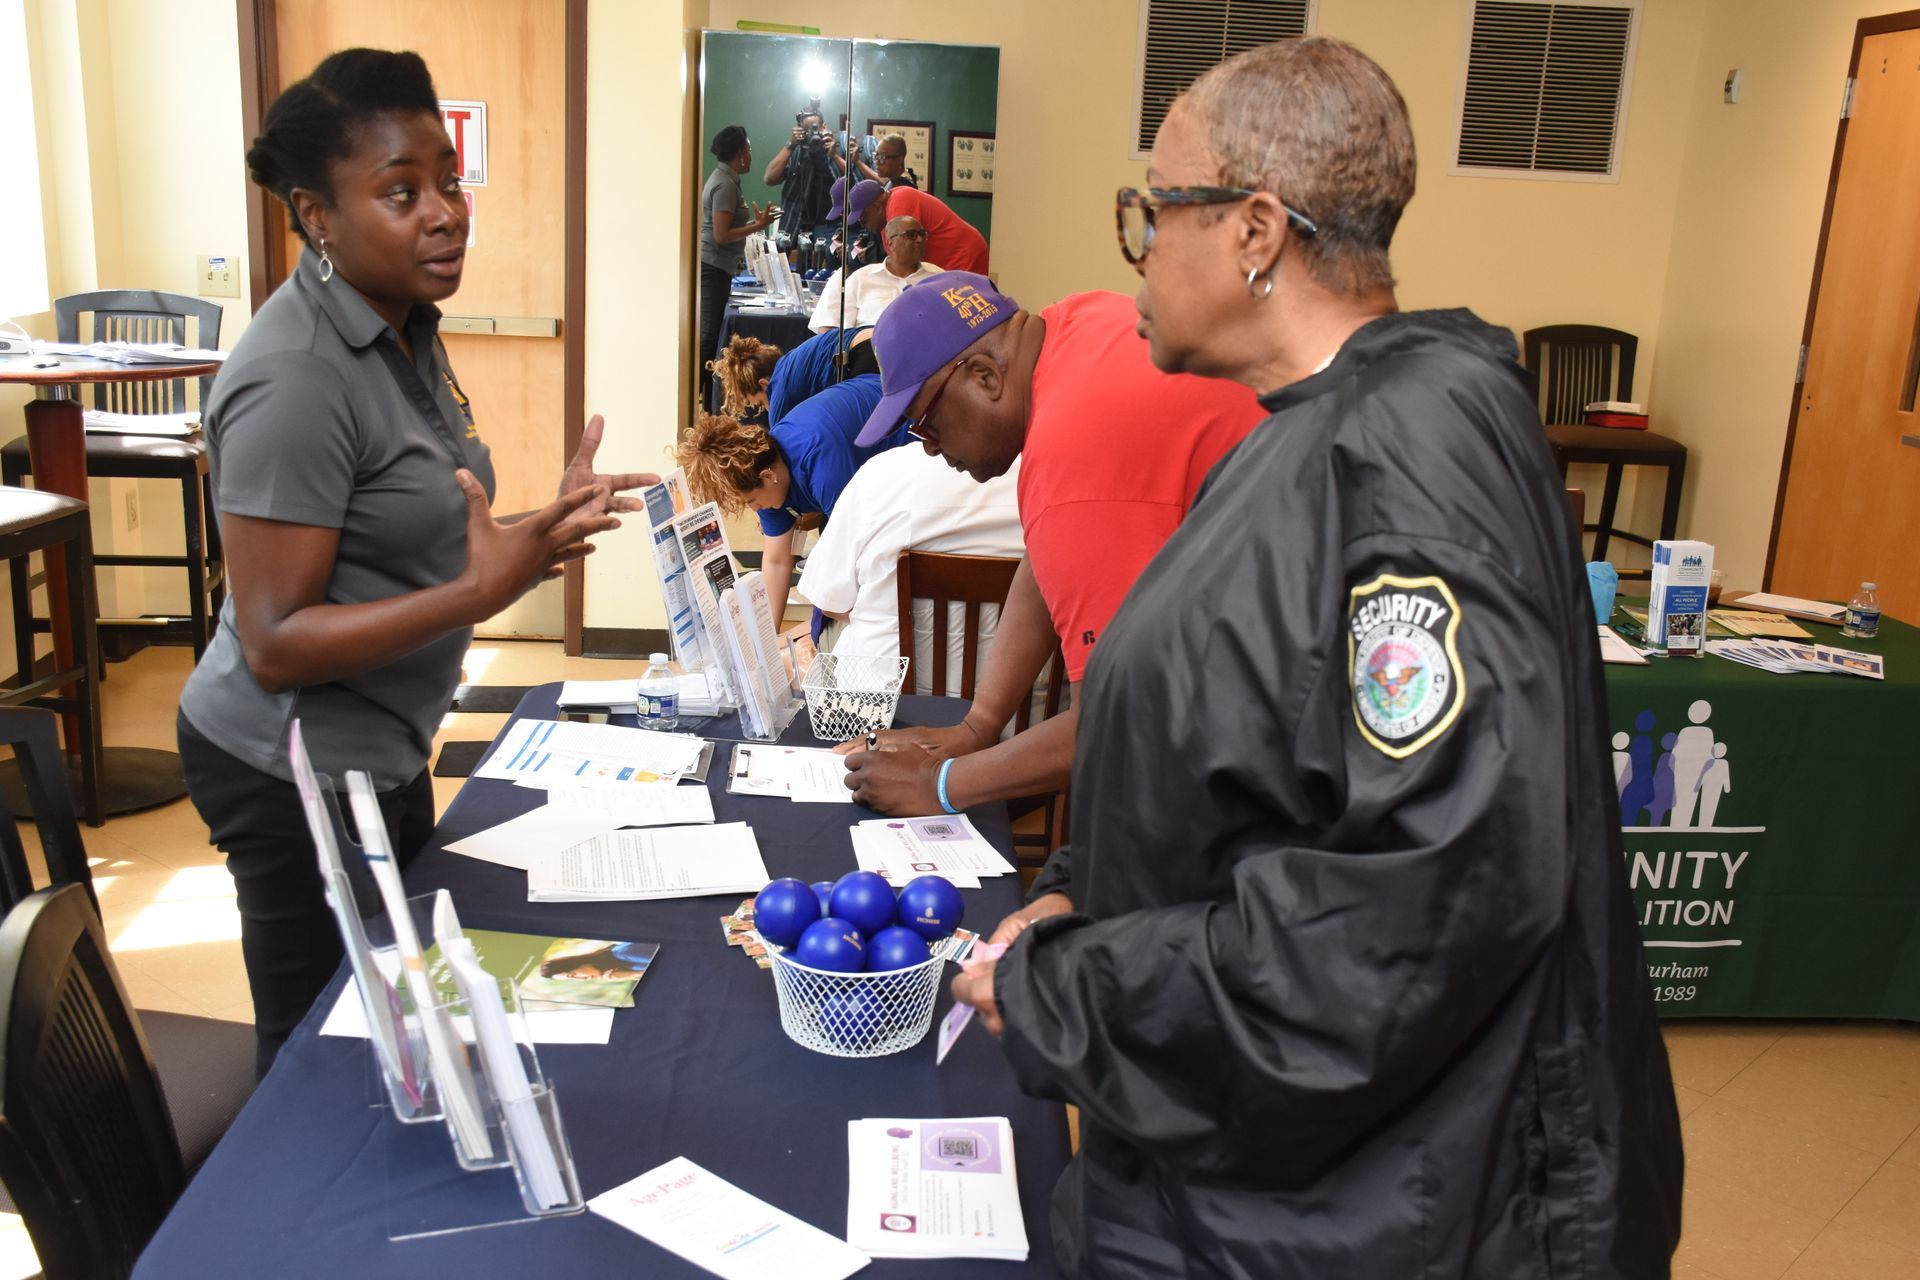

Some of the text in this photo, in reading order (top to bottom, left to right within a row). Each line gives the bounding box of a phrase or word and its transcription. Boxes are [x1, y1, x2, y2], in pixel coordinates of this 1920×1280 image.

[967, 304, 998, 329] 1975-2015
[694, 512, 715, 527] DEMENTIA
[1352, 594, 1447, 641] SECURITY
[1624, 851, 1749, 889] NITY
[1637, 900, 1734, 926] ITION
[1647, 962, 1709, 978] urham
[1653, 985, 1696, 1002] 1989
